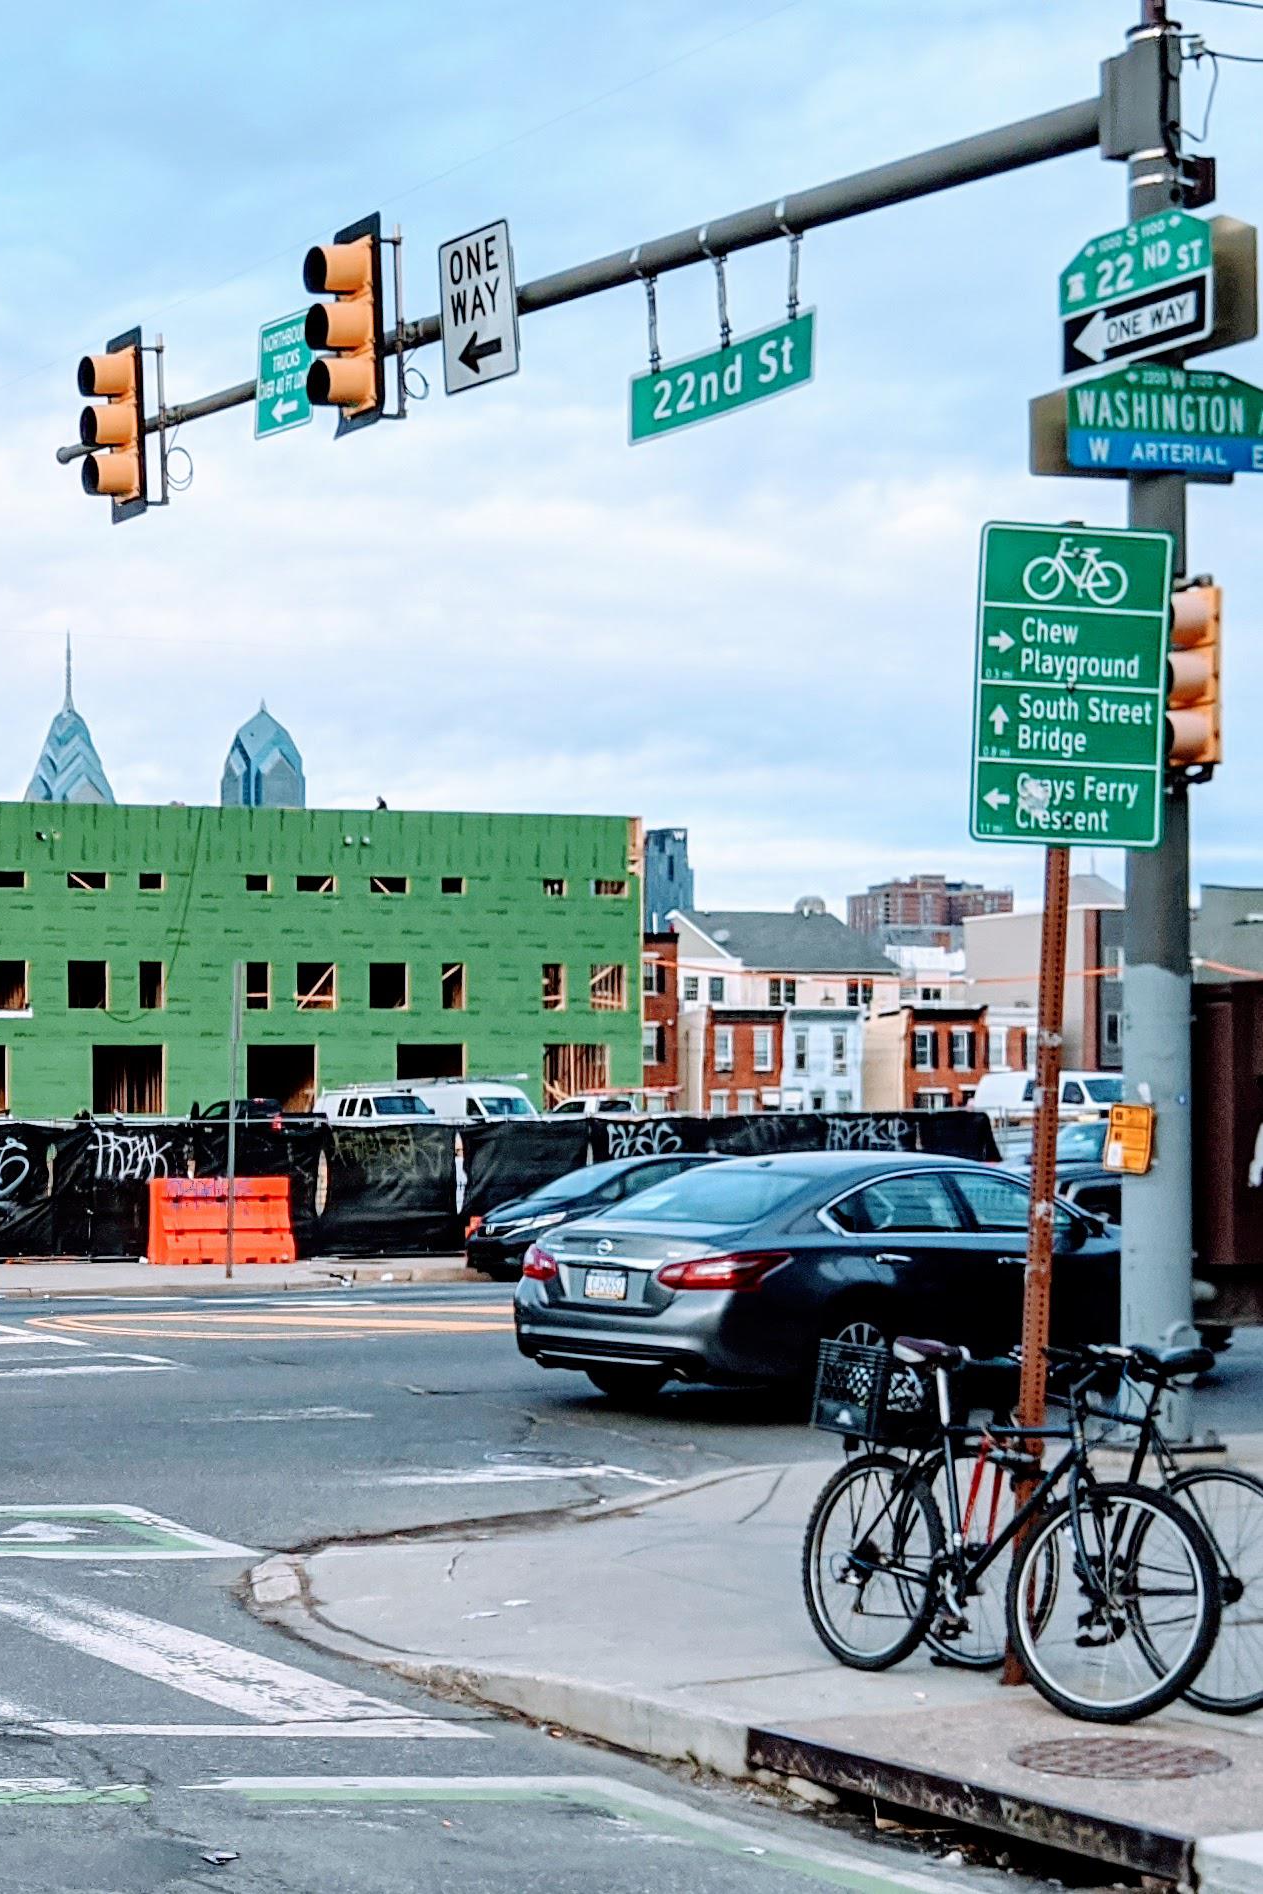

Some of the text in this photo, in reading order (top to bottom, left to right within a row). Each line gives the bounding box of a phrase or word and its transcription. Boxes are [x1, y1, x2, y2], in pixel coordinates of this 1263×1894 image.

[1126, 226, 1138, 246] S
[450, 234, 498, 286] ONE
[1177, 239, 1204, 271] ST
[451, 277, 500, 327] WAY
[1107, 299, 1188, 344] ONE WAY
[273, 348, 300, 373] TRUCKS
[652, 335, 794, 422] 22nd St
[1170, 369, 1186, 390] W
[1075, 389, 1244, 435] WASHINGTON
[1088, 437, 1111, 464] W
[1131, 441, 1228, 467] ARTERIAL
[1022, 617, 1079, 646] Chew
[1020, 648, 1140, 682] Playground
[1018, 693, 1153, 726] South Street
[1017, 726, 1087, 759] Bridge
[1084, 775, 1139, 809] Ferry
